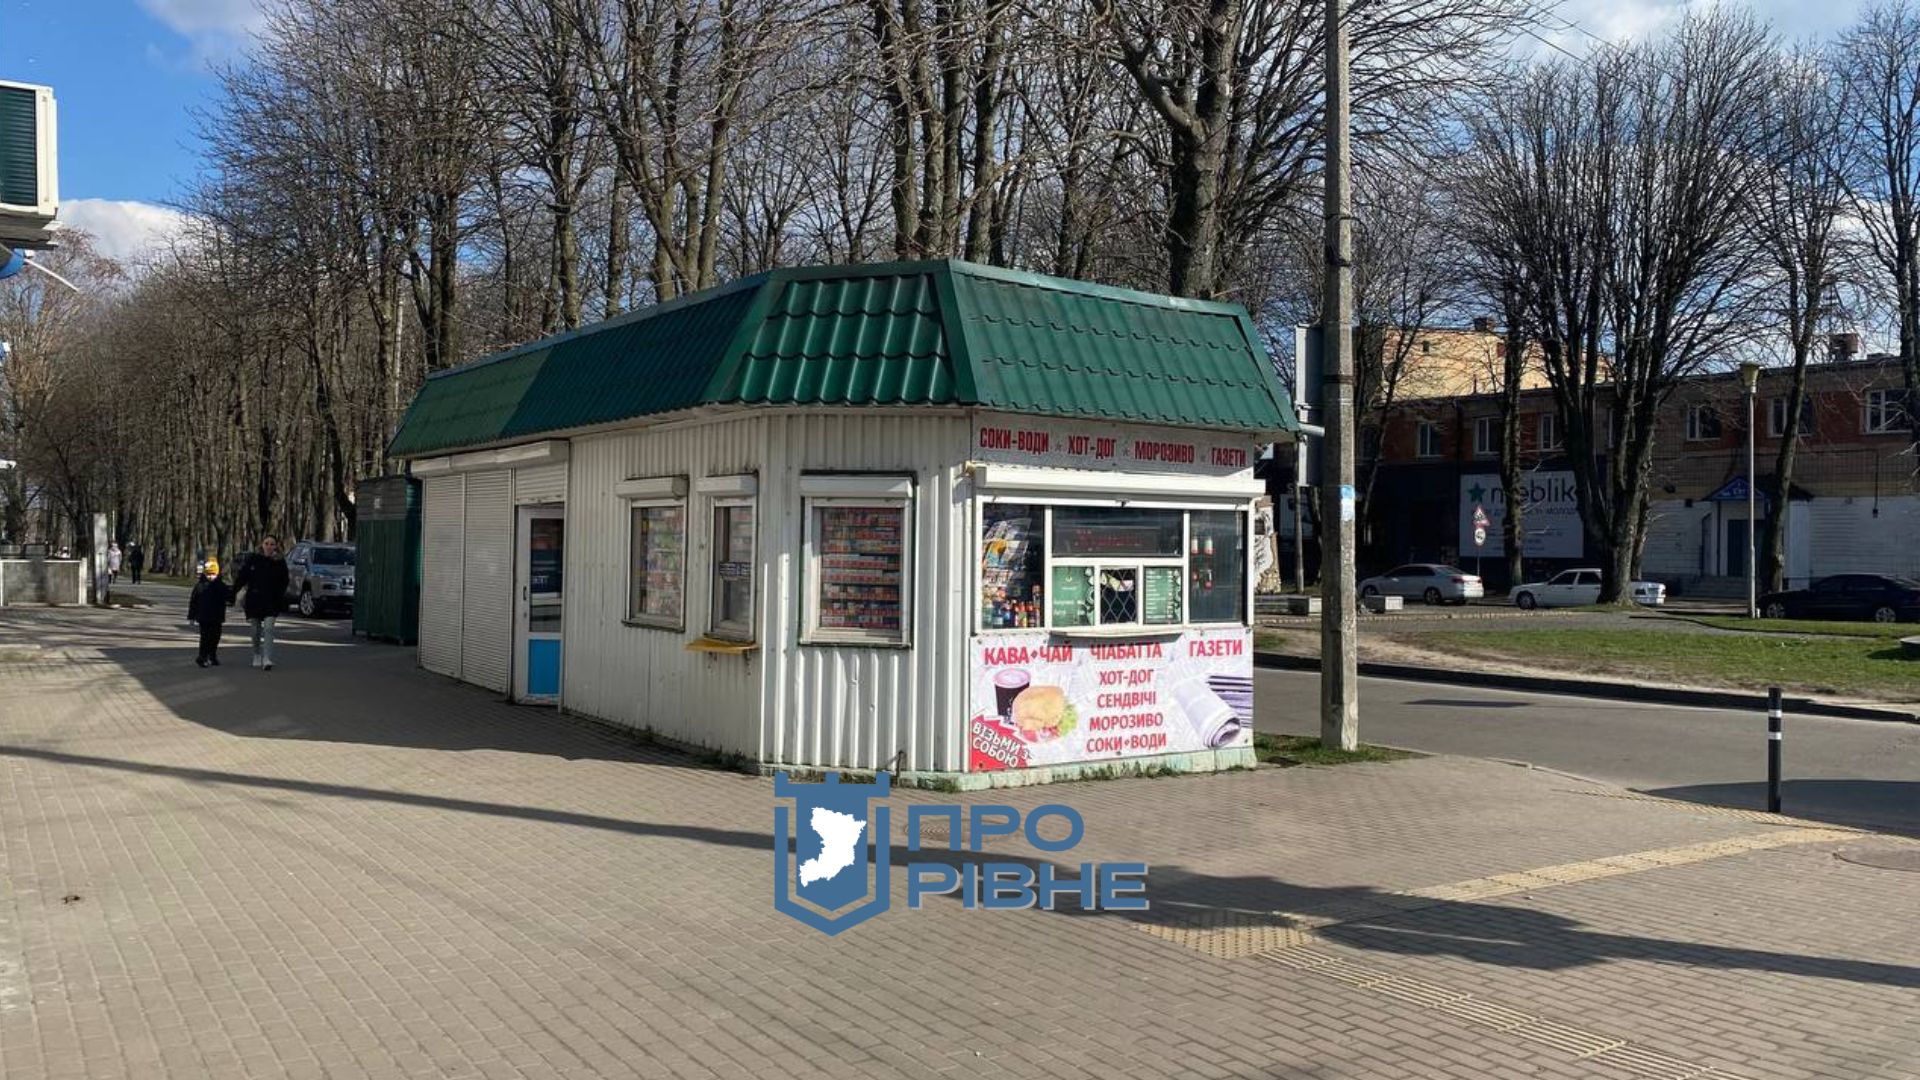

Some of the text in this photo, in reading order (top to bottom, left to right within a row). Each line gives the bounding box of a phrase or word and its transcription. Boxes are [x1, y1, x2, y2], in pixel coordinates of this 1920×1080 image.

[980, 427, 1246, 468] СОКИ-ВОДИ ХОТ-ДОГ МОРОЗИВО ГАЗЕТИ
[1090, 642, 1162, 660] ЧІАБАТТА
[1189, 640, 1242, 657] ГАЗЕТИ
[1099, 669, 1154, 686] ХОТ-ДОГ
[1097, 691, 1156, 710] СЕНДВІЧІ
[1089, 712, 1164, 731] МОРОЗИВО
[972, 722, 1020, 755] ВІЗЬМИ
[972, 737, 1018, 768] СОБОЮ
